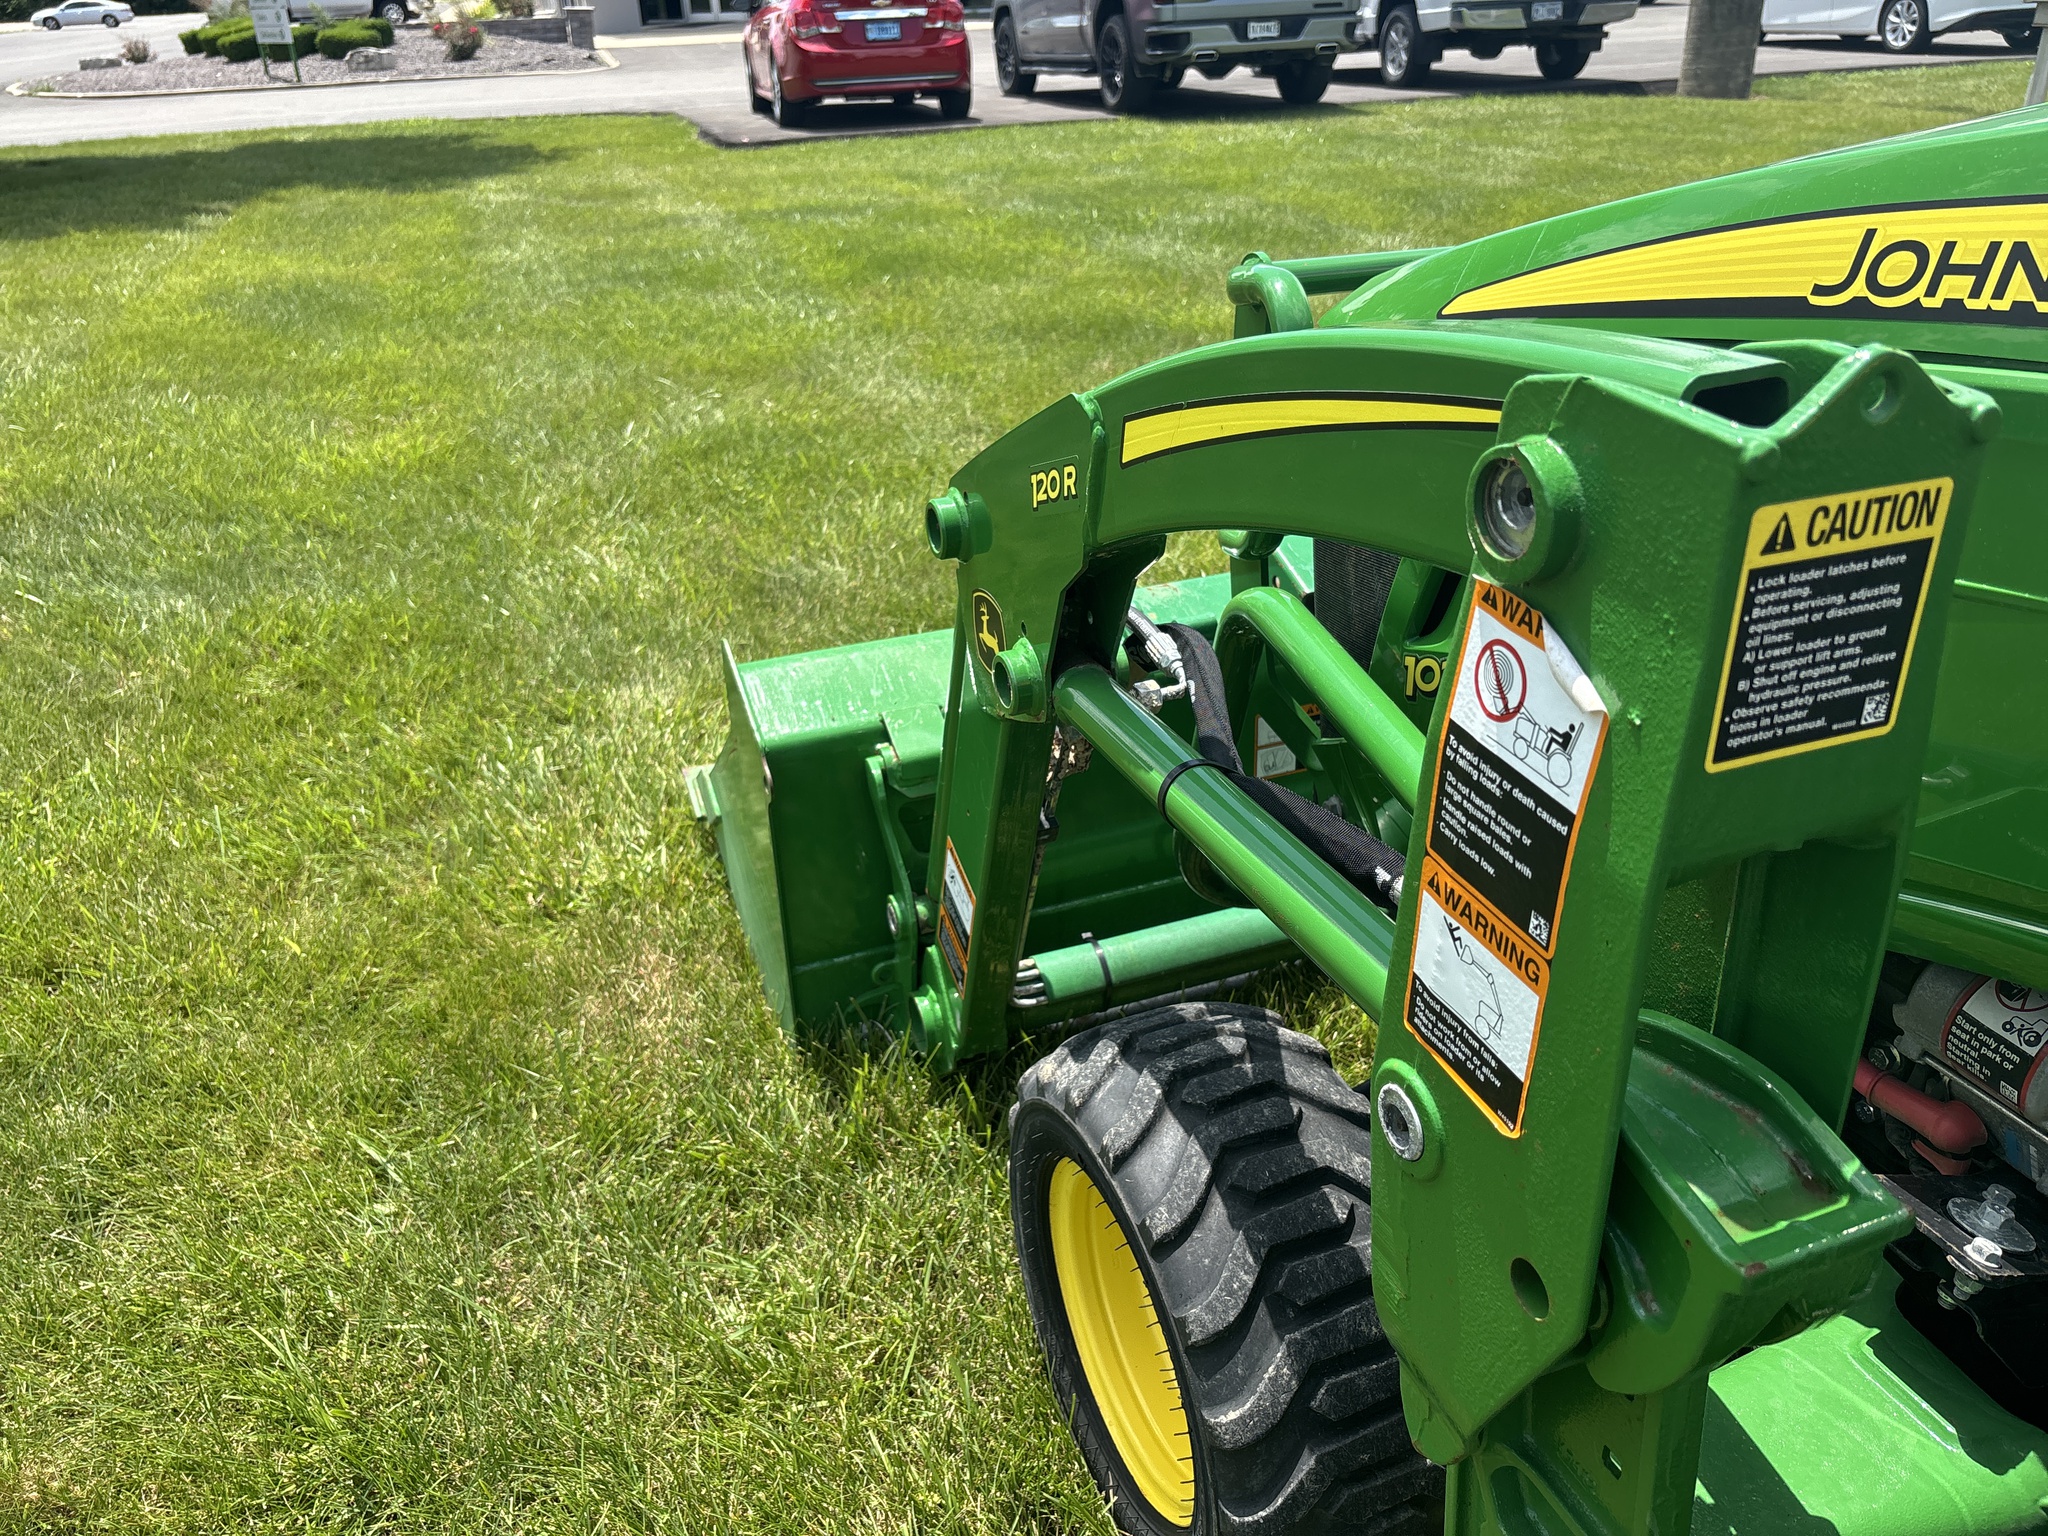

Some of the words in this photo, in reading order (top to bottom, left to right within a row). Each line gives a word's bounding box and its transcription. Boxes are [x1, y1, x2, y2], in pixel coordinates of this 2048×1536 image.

[1809, 228, 2048, 306] JOHN
[1806, 487, 1943, 548] CAUTION
[1757, 574, 1787, 590] Lock
[1788, 568, 1826, 584] loader
[1827, 561, 1870, 577] latches
[1871, 553, 1908, 569] before
[1748, 613, 1810, 634] equipment
[1811, 612, 1825, 622] or
[1825, 596, 1903, 619] disconnecting
[1751, 604, 1791, 619] Before
[1849, 584, 1901, 601] adjusting
[1754, 586, 1812, 605] operating.
[1742, 650, 1757, 664] A)
[1757, 645, 1794, 660] Lower
[1795, 638, 1833, 652] loader
[1833, 635, 1846, 645] to
[1847, 626, 1888, 644] ground
[1745, 636, 1762, 648] oil
[1762, 632, 1794, 645] lines:
[1753, 664, 1768, 674] or
[1768, 654, 1814, 672] support
[1814, 650, 1832, 662] lift
[1832, 646, 1863, 660] arms.
[1737, 679, 1751, 692] B)
[1752, 675, 1779, 689] Shut
[1780, 670, 1799, 683] off
[1798, 664, 1838, 679] engine
[1838, 658, 1861, 671] and
[1860, 651, 1897, 666] relieve
[1748, 685, 1801, 704] hydraulic
[1801, 675, 1852, 694] pressure.
[1731, 703, 1779, 719] Observe
[1780, 694, 1816, 709] safety
[1816, 679, 1890, 702] recommenda-
[1726, 727, 1784, 748] operator's
[1785, 716, 1828, 734] manual.
[1729, 720, 1758, 734] tions
[1759, 716, 1771, 727] in
[1772, 709, 1809, 724] loader
[1445, 745, 1456, 761] by
[1456, 754, 1479, 781] falling
[1479, 772, 1503, 799] loads:
[1449, 734, 1459, 749] To
[1458, 745, 1479, 766] avoid
[1479, 759, 1502, 785] injury
[1502, 780, 1513, 791] or
[1512, 788, 1537, 811] death
[1536, 807, 1569, 836] caused
[1441, 810, 1468, 839] caution.
[1444, 781, 1462, 803] large
[1462, 800, 1489, 825] square
[1490, 819, 1513, 845] bales.
[1446, 770, 1457, 785] Do
[1457, 781, 1470, 797] not
[1470, 791, 1497, 818] handle
[1497, 813, 1521, 839] round
[1521, 835, 1532, 847] or
[1439, 822, 1458, 846] Carry
[1458, 839, 1480, 863] loads
[1480, 857, 1496, 877] low.
[1442, 797, 1467, 825] Handle
[1467, 820, 1492, 845] raised
[1492, 839, 1514, 864] loads
[1514, 859, 1533, 880] with
[1443, 881, 1541, 987] WARNING
[1413, 1016, 1455, 1062] attachments.
[1414, 1006, 1433, 1030] riders
[1433, 1027, 1443, 1040] on
[1444, 1034, 1466, 1062] loader
[1466, 1059, 1475, 1071] or
[1475, 1068, 1485, 1082] its
[1415, 979, 1423, 994] To
[1423, 990, 1441, 1011] avoid
[1441, 1008, 1462, 1034] injury
[1462, 1028, 1480, 1051] from
[1480, 1046, 1499, 1070] falls:
[1416, 996, 1425, 1011] Do
[1424, 1007, 1437, 1024] not
[1437, 1020, 1456, 1041] work
[1455, 1036, 1472, 1059] from
[1472, 1055, 1482, 1067] or
[1481, 1064, 1502, 1088] allow
[1955, 1015, 1977, 1035] Start
[1977, 1032, 1998, 1049] only
[1998, 1044, 2020, 1064] from
[1946, 1041, 1980, 1070] Starting
[1982, 1065, 1991, 1077] in
[1948, 1034, 1980, 1060] neutral.
[1950, 1025, 1970, 1042] seat
[1970, 1037, 1980, 1049] in
[1980, 1046, 2002, 1064] park
[2002, 1060, 2014, 1071] or
